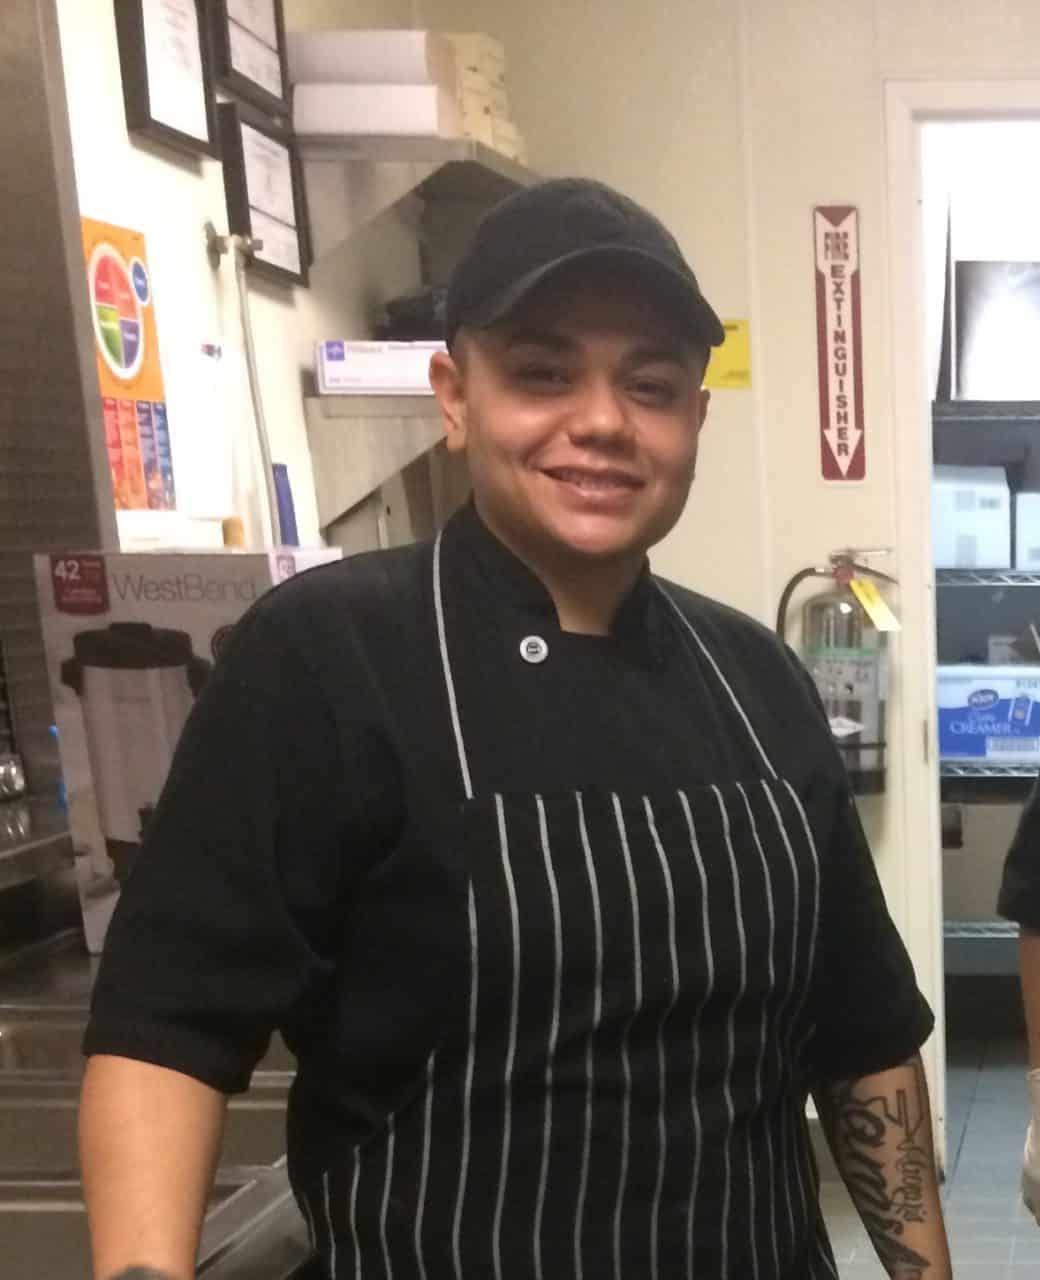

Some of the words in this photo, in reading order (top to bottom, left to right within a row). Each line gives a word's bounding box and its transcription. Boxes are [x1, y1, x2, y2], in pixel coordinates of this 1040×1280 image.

[829, 264, 850, 457] EXTINGUISHER
[54, 560, 81, 580] 42
[113, 574, 258, 602] WestBend
